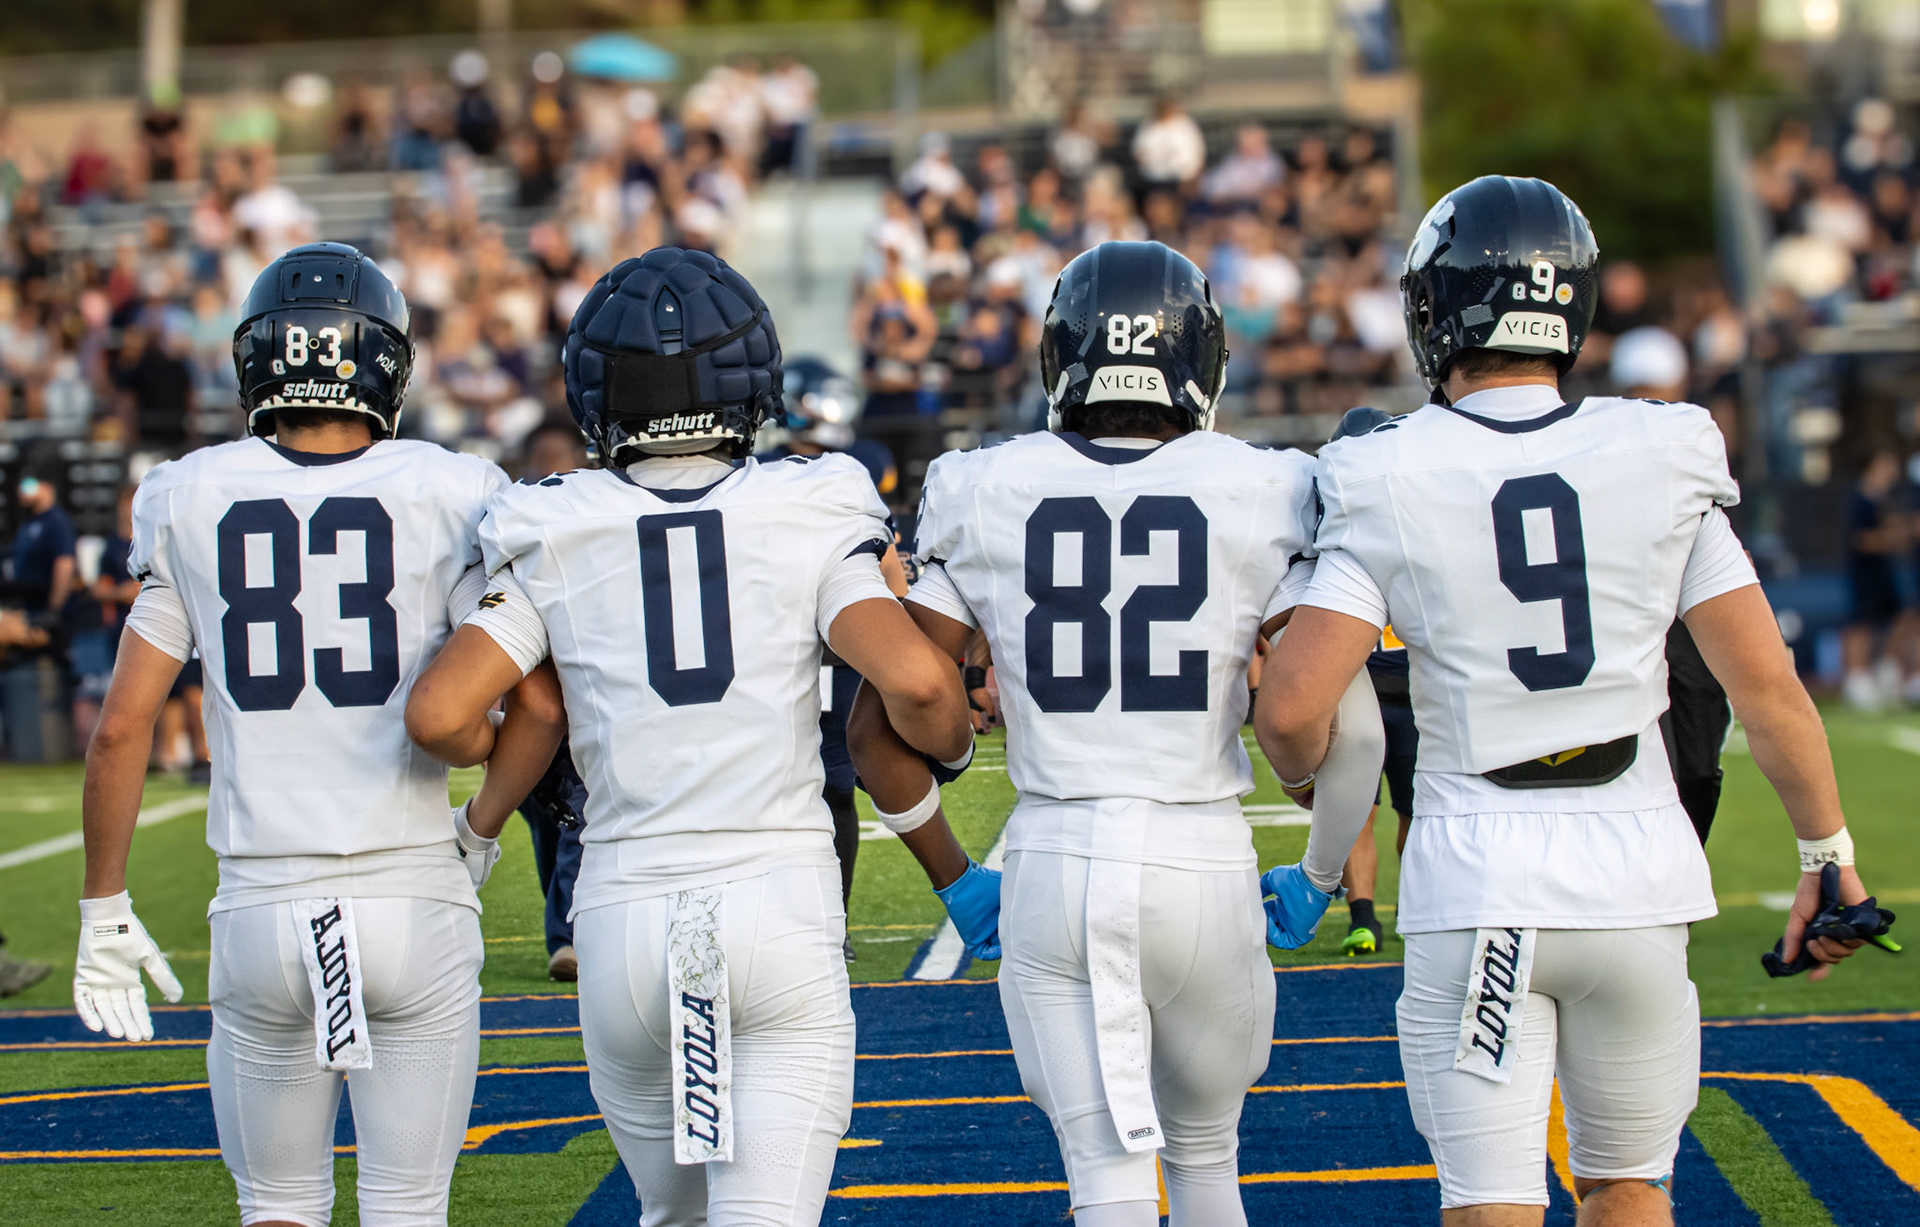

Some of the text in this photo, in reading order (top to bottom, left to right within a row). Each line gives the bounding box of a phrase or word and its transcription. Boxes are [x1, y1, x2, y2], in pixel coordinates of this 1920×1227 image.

[1530, 260, 1555, 303] 9
[285, 325, 342, 367] 83
[1107, 314, 1157, 355] 82
[1505, 320, 1561, 338] VICIS
[282, 379, 349, 399] schutt
[1099, 375, 1158, 391] VICIS
[647, 412, 715, 433] schutt
[1491, 472, 1596, 692] 9
[217, 496, 401, 712] 83
[638, 509, 735, 707] 0
[1025, 495, 1208, 713] 82
[682, 991, 719, 1148] LOYOLA
